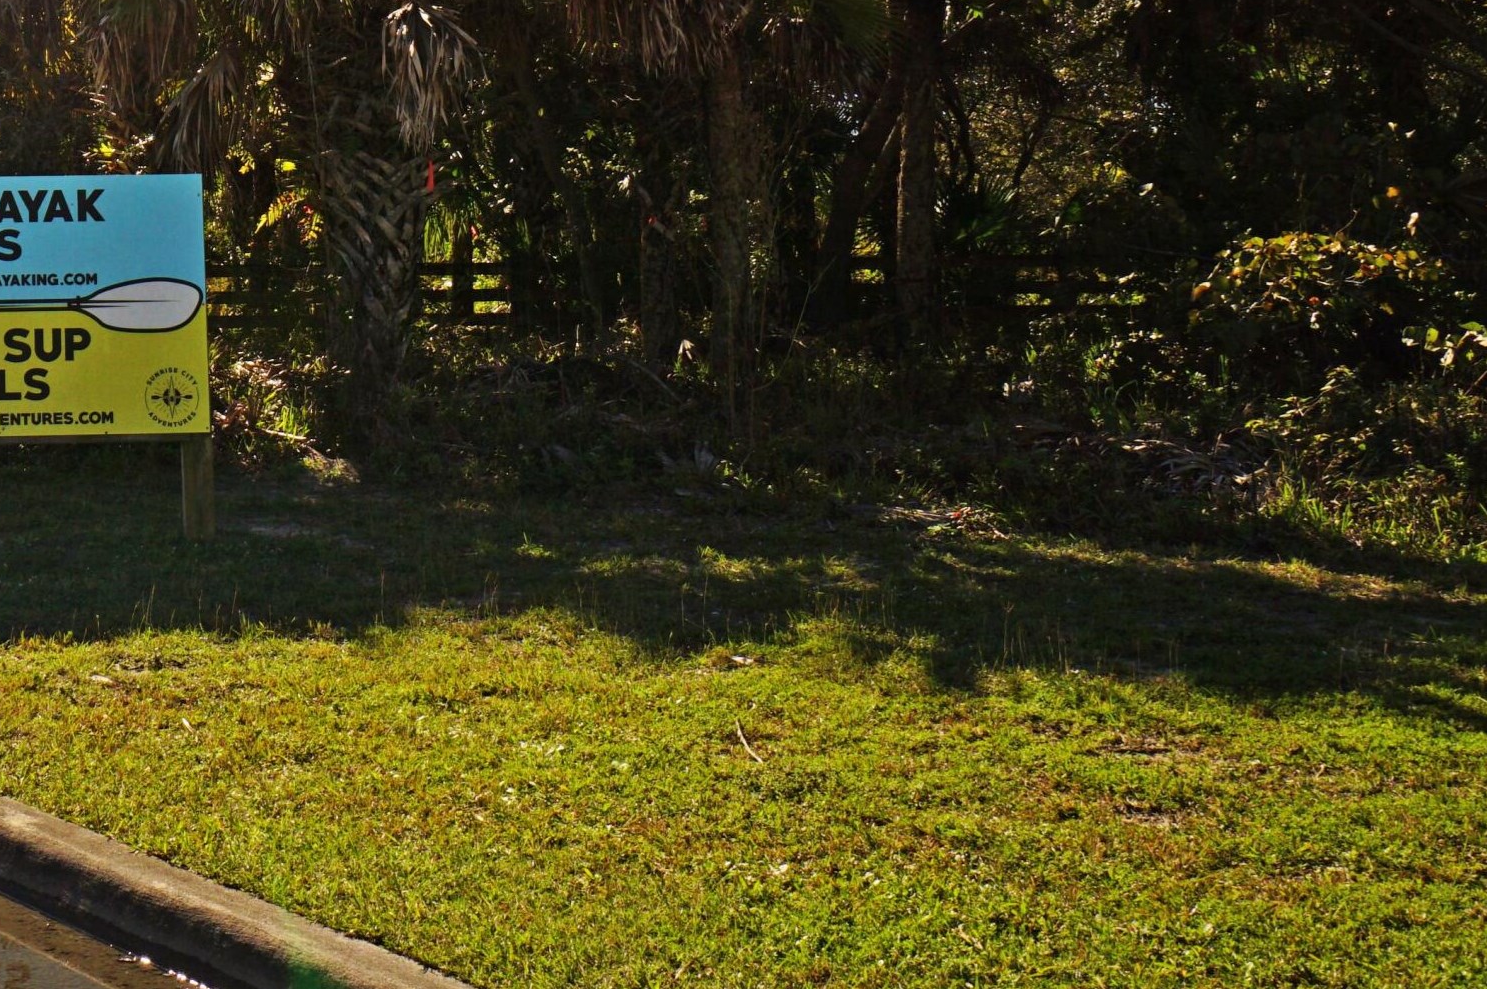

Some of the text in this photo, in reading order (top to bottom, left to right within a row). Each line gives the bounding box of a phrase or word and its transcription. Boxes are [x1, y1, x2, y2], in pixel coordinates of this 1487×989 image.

[3, 327, 92, 364] SUP
[146, 366, 198, 386] SUNRISE CITY
[148, 411, 197, 428] ADVENTURES
